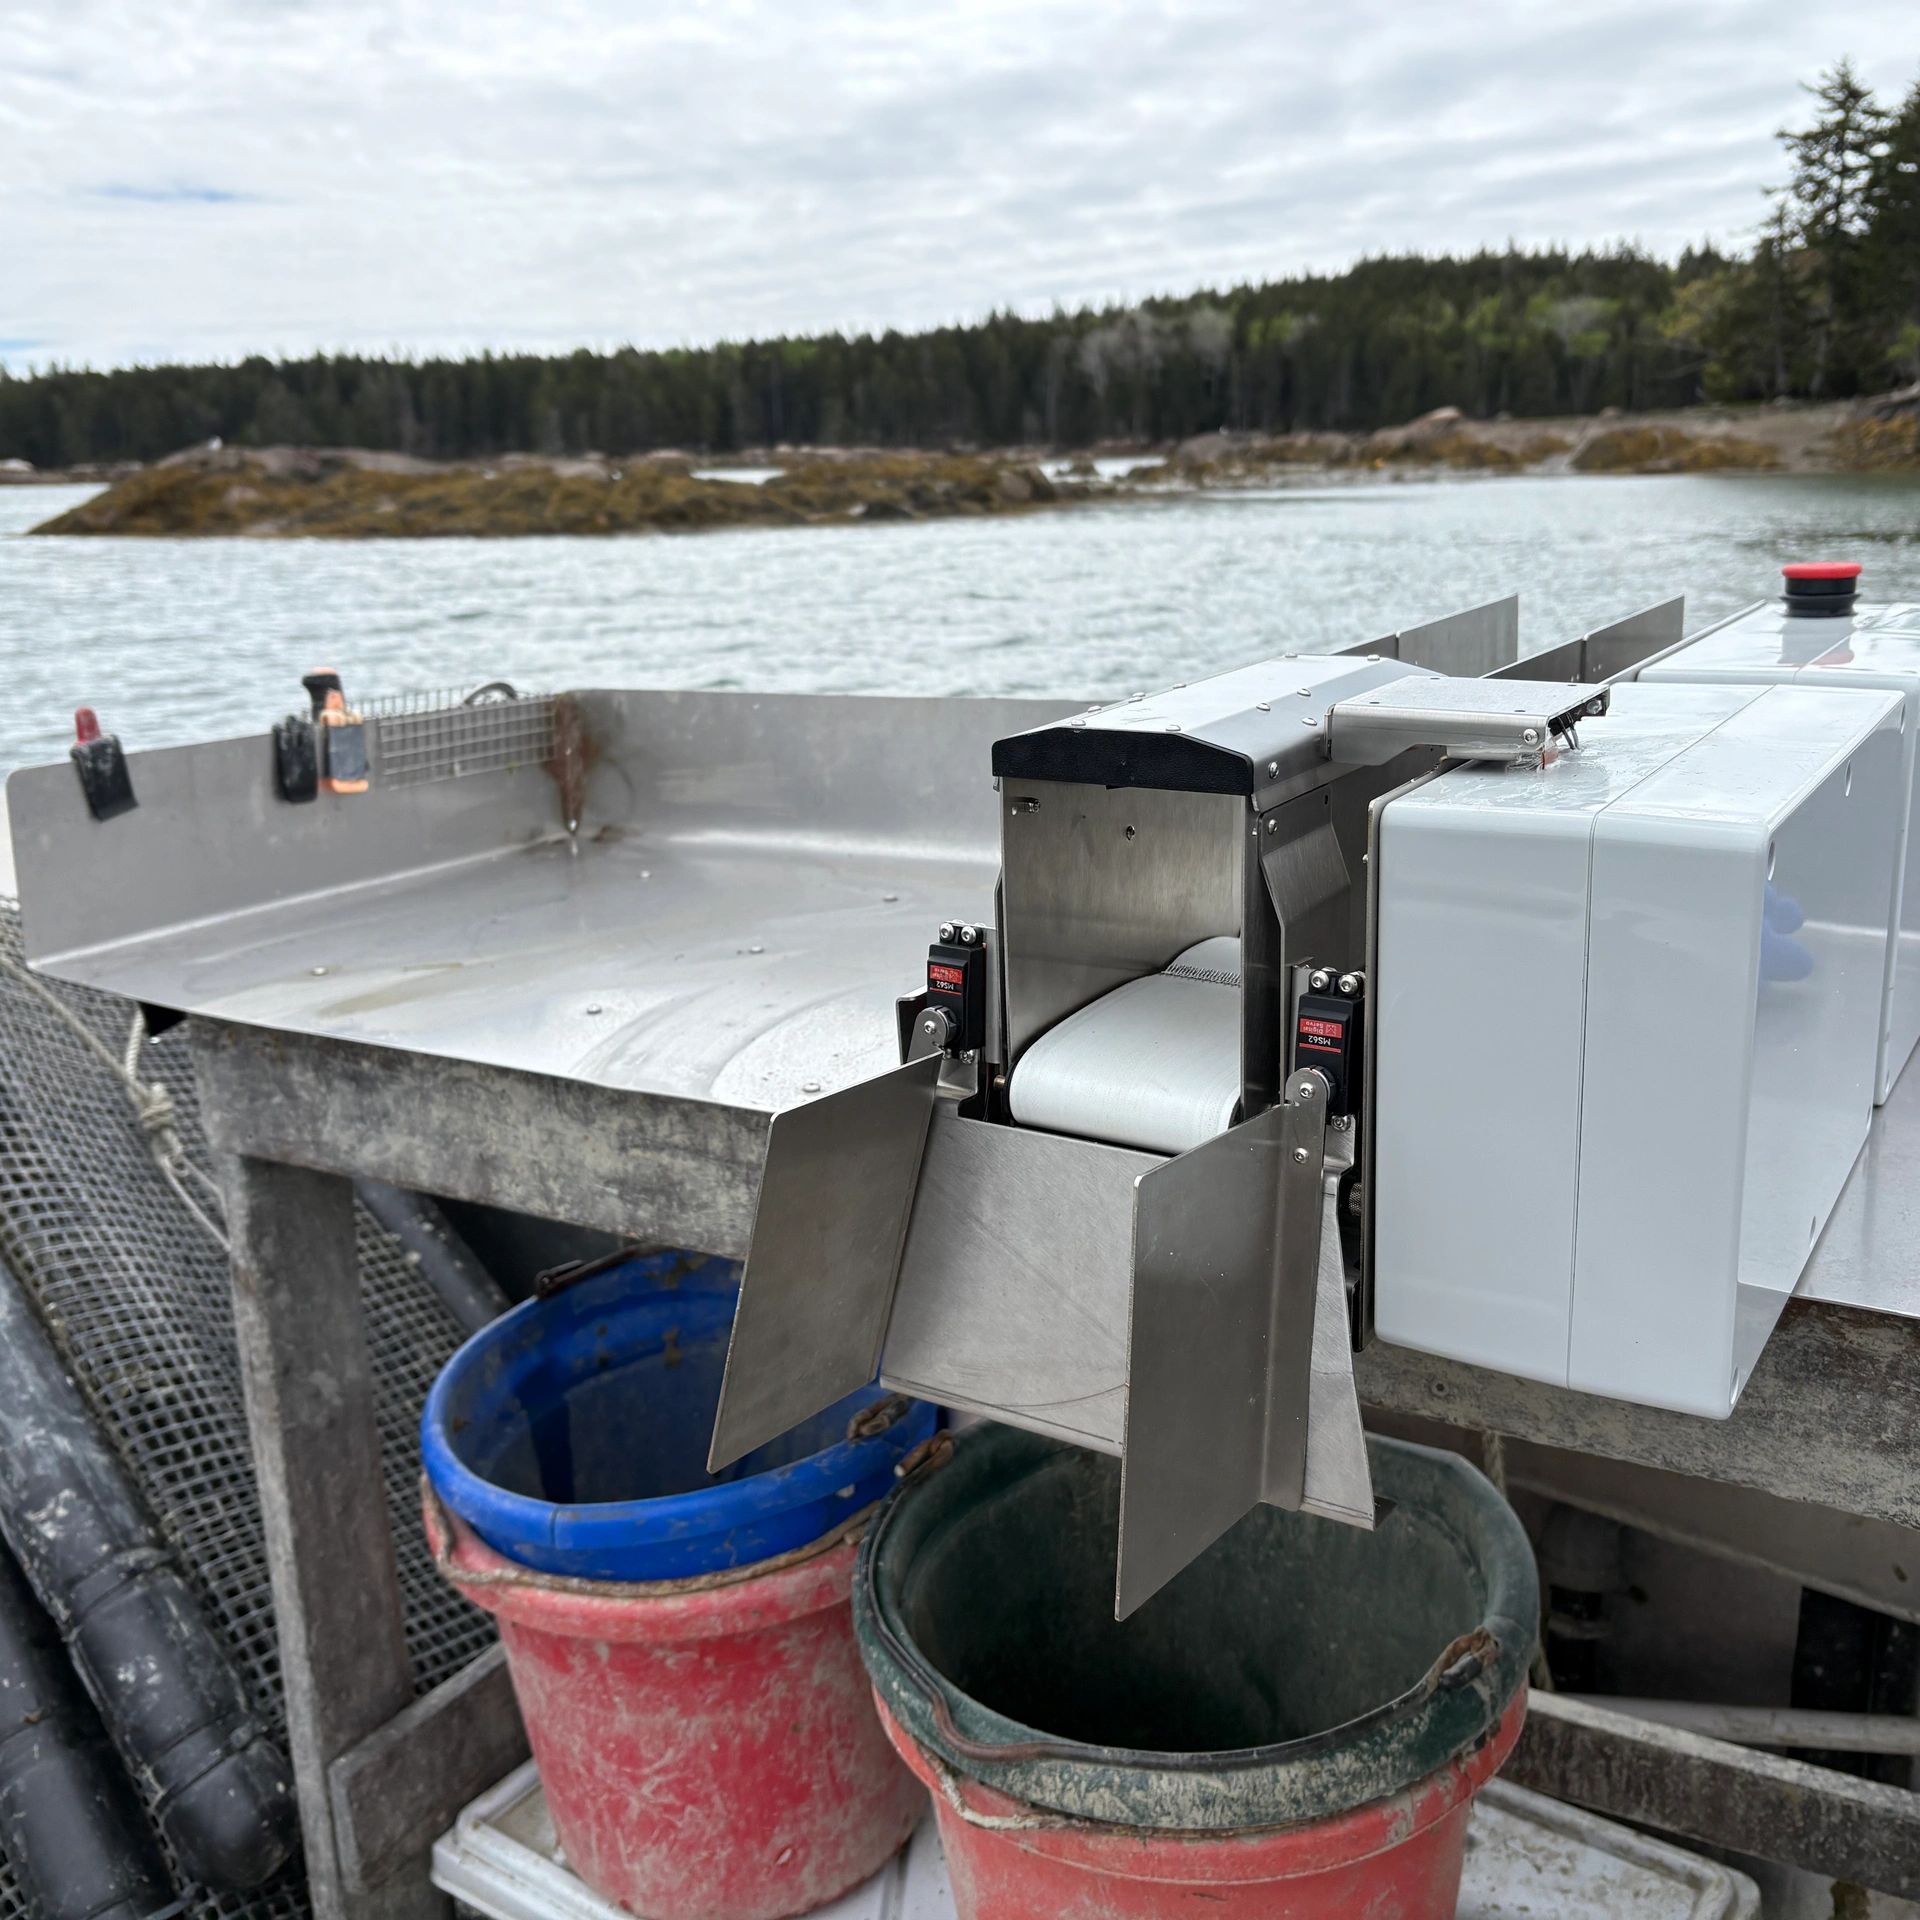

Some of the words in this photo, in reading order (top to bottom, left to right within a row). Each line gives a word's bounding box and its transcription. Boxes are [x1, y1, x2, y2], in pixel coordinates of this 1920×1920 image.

[936, 981, 954, 990] MS62
[1305, 1021, 1324, 1029] Servo
[1303, 1026, 1324, 1035] Digital
[1308, 1035, 1331, 1046] MS62
